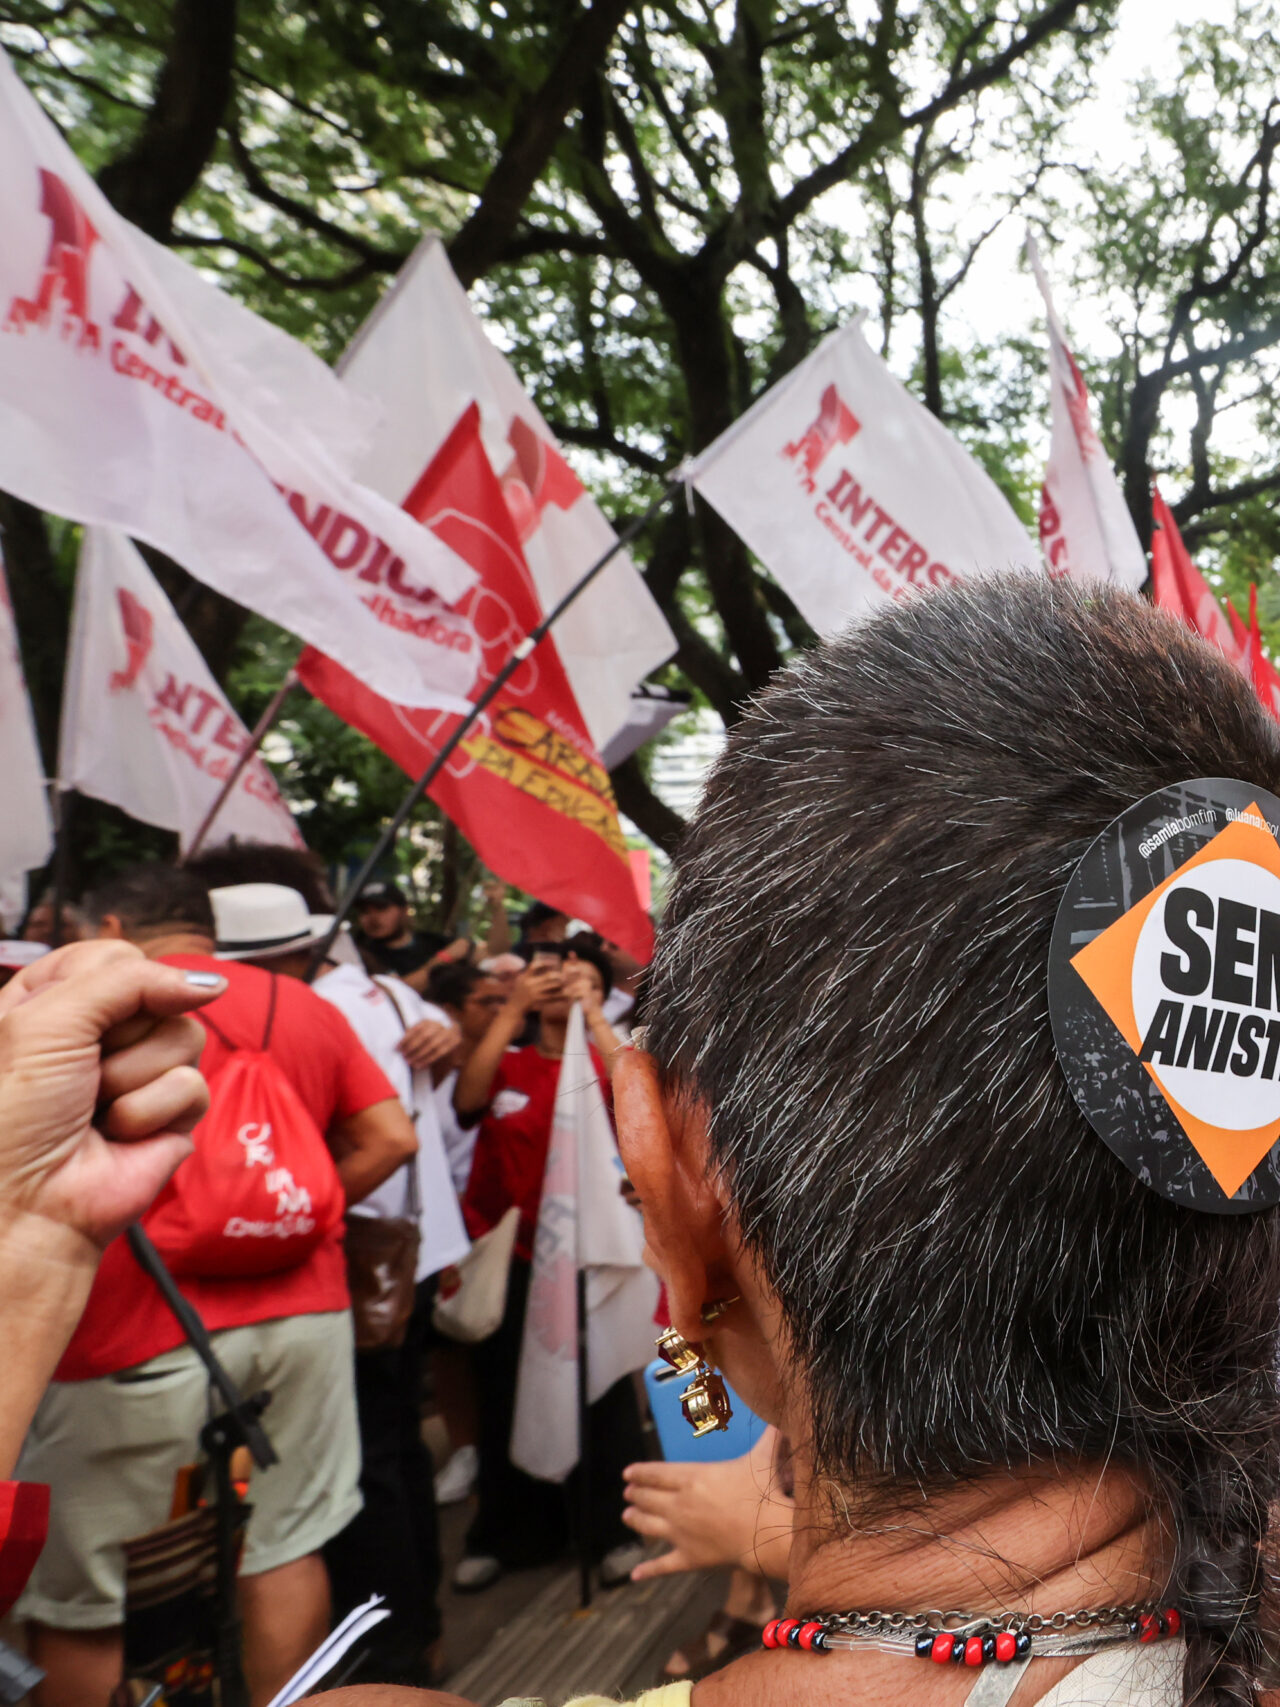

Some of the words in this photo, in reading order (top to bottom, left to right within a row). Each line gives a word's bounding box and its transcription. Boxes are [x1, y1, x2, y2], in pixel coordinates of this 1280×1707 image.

[826, 466, 962, 592] INTERS
[1138, 808, 1217, 860] @samiabomfim
[1225, 807, 1280, 838] @luanapsol
